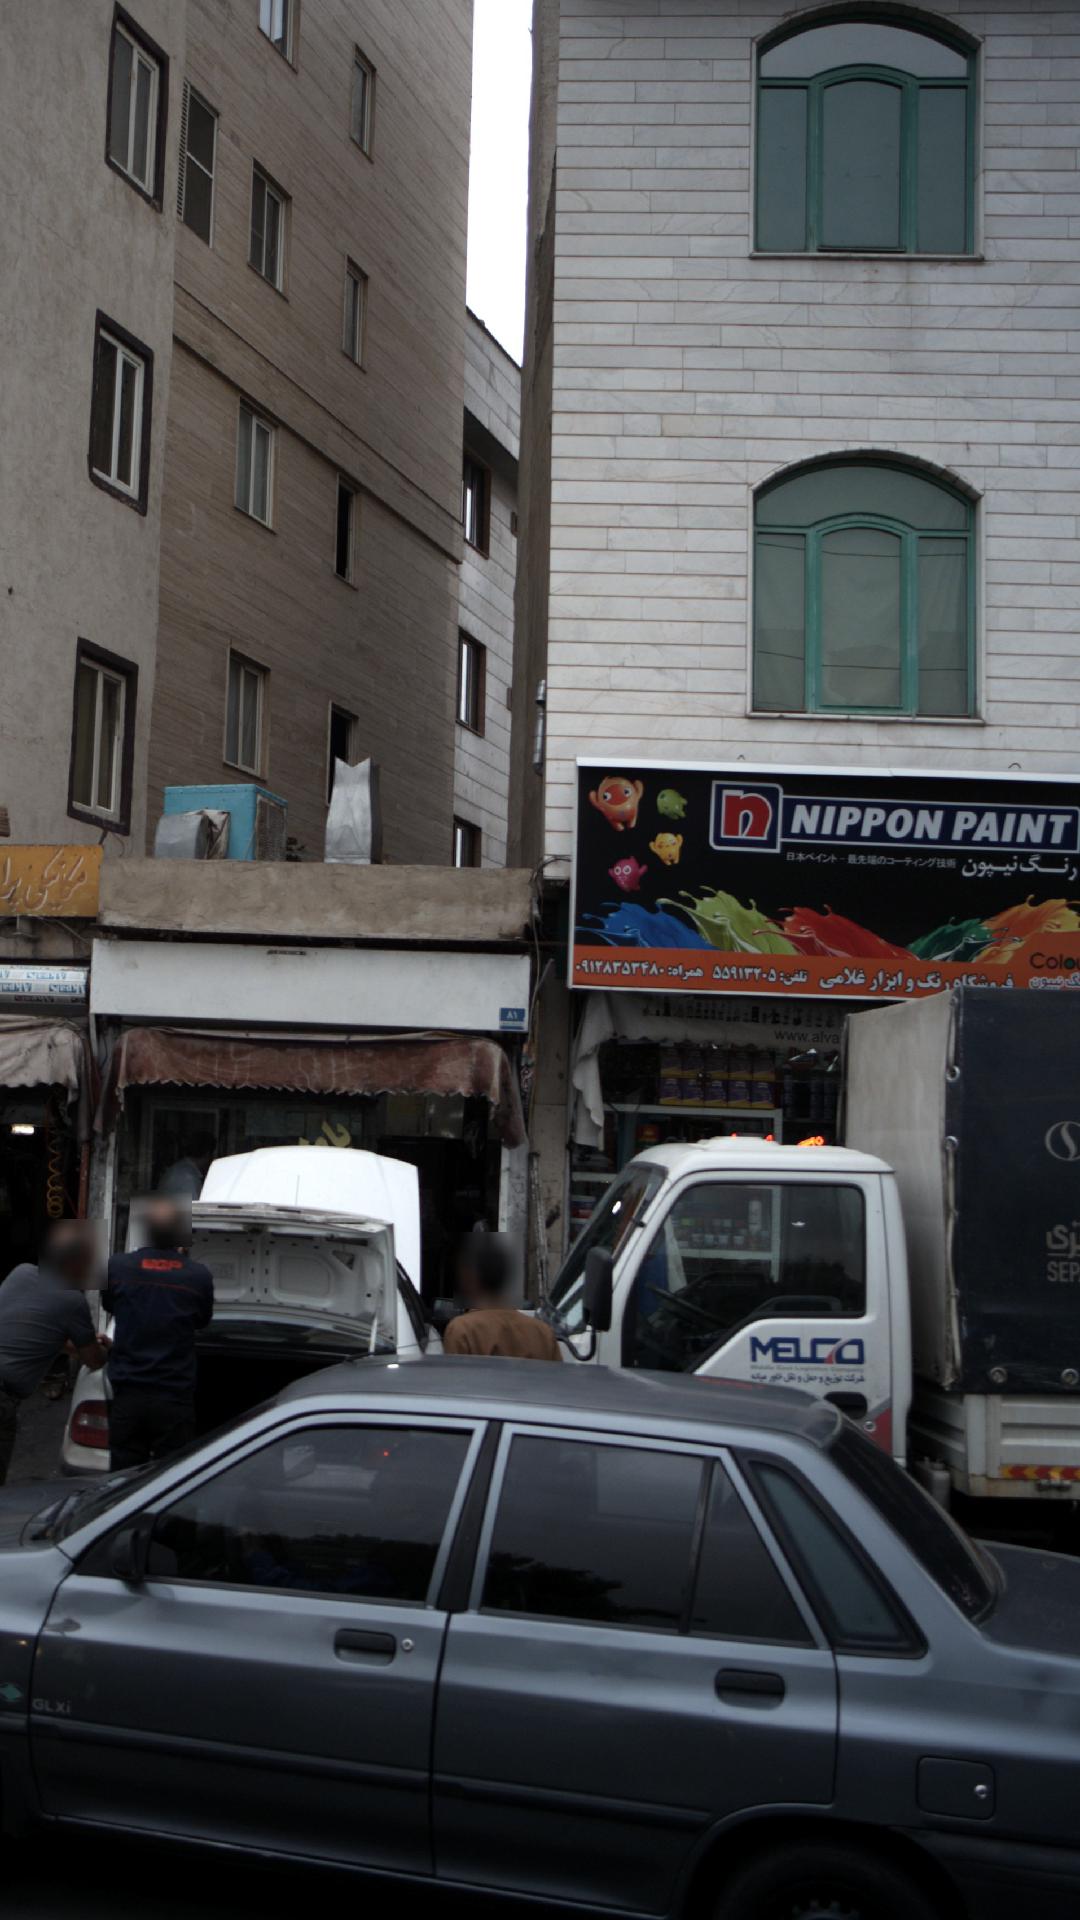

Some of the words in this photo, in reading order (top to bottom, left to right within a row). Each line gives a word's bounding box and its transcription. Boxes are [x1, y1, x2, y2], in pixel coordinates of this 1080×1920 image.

[790, 804, 944, 839] NIPPON
[951, 811, 1073, 844] PAINT
[785, 852, 838, 864] 日本ペイント
[961, 855, 1018, 878] نیپون
[1019, 854, 1078, 881] رنگ
[0, 856, 23, 912] پرا
[819, 967, 866, 989] غلامی
[868, 969, 904, 992] ابزار
[905, 977, 915, 993] و
[774, 1030, 840, 1044] www.alva
[1046, 1261, 1080, 1283] SEP
[750, 1336, 865, 1365] MELCO
[32, 1697, 72, 1714] GLXi
